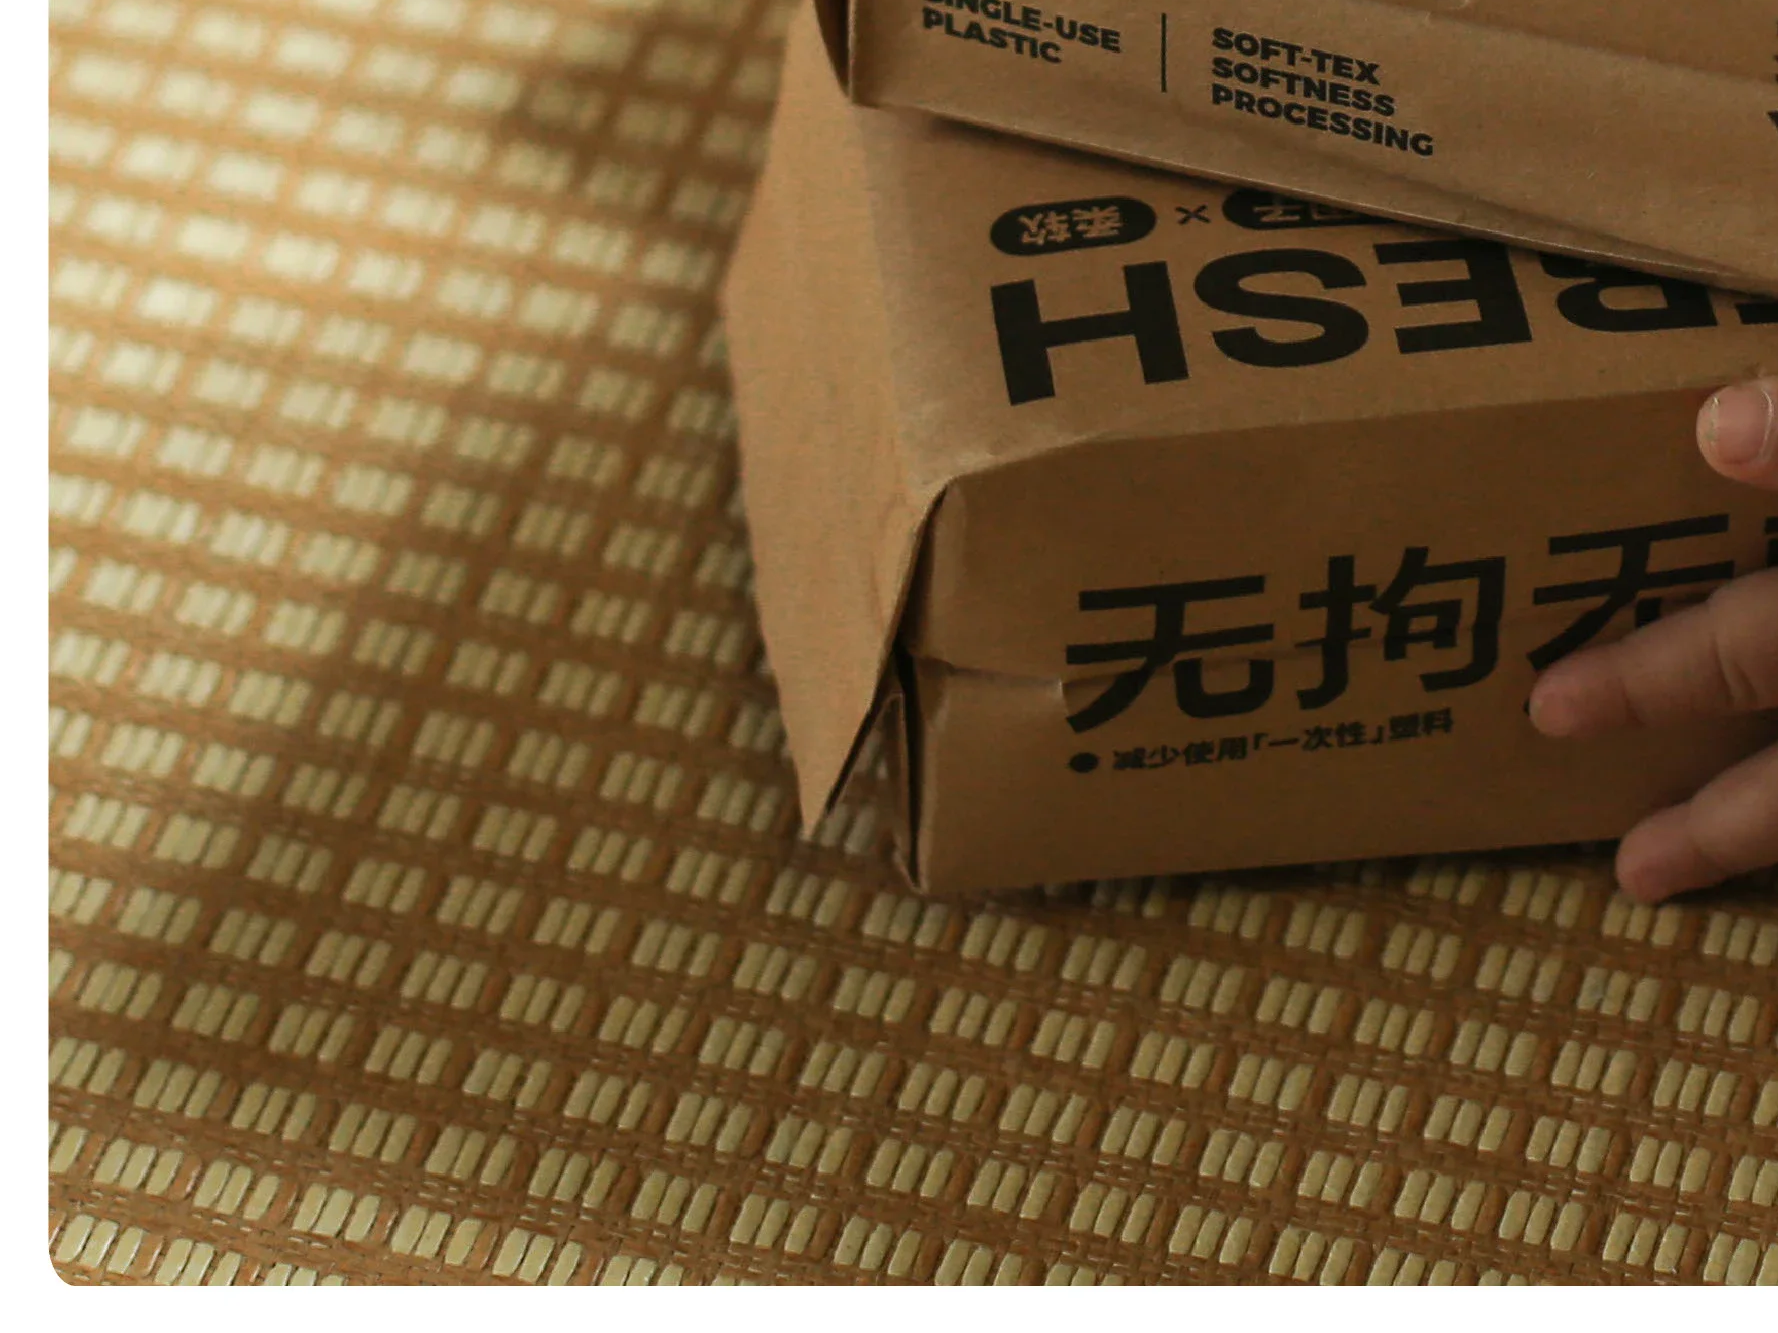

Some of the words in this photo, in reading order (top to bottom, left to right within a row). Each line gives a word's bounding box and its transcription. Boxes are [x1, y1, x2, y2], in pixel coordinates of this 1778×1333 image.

[921, 7, 1063, 65] PLASTIC
[1211, 27, 1382, 86] SOFT-TEX
[1211, 57, 1396, 117] SOFTNESS
[1210, 82, 1435, 158] PROCESSING
